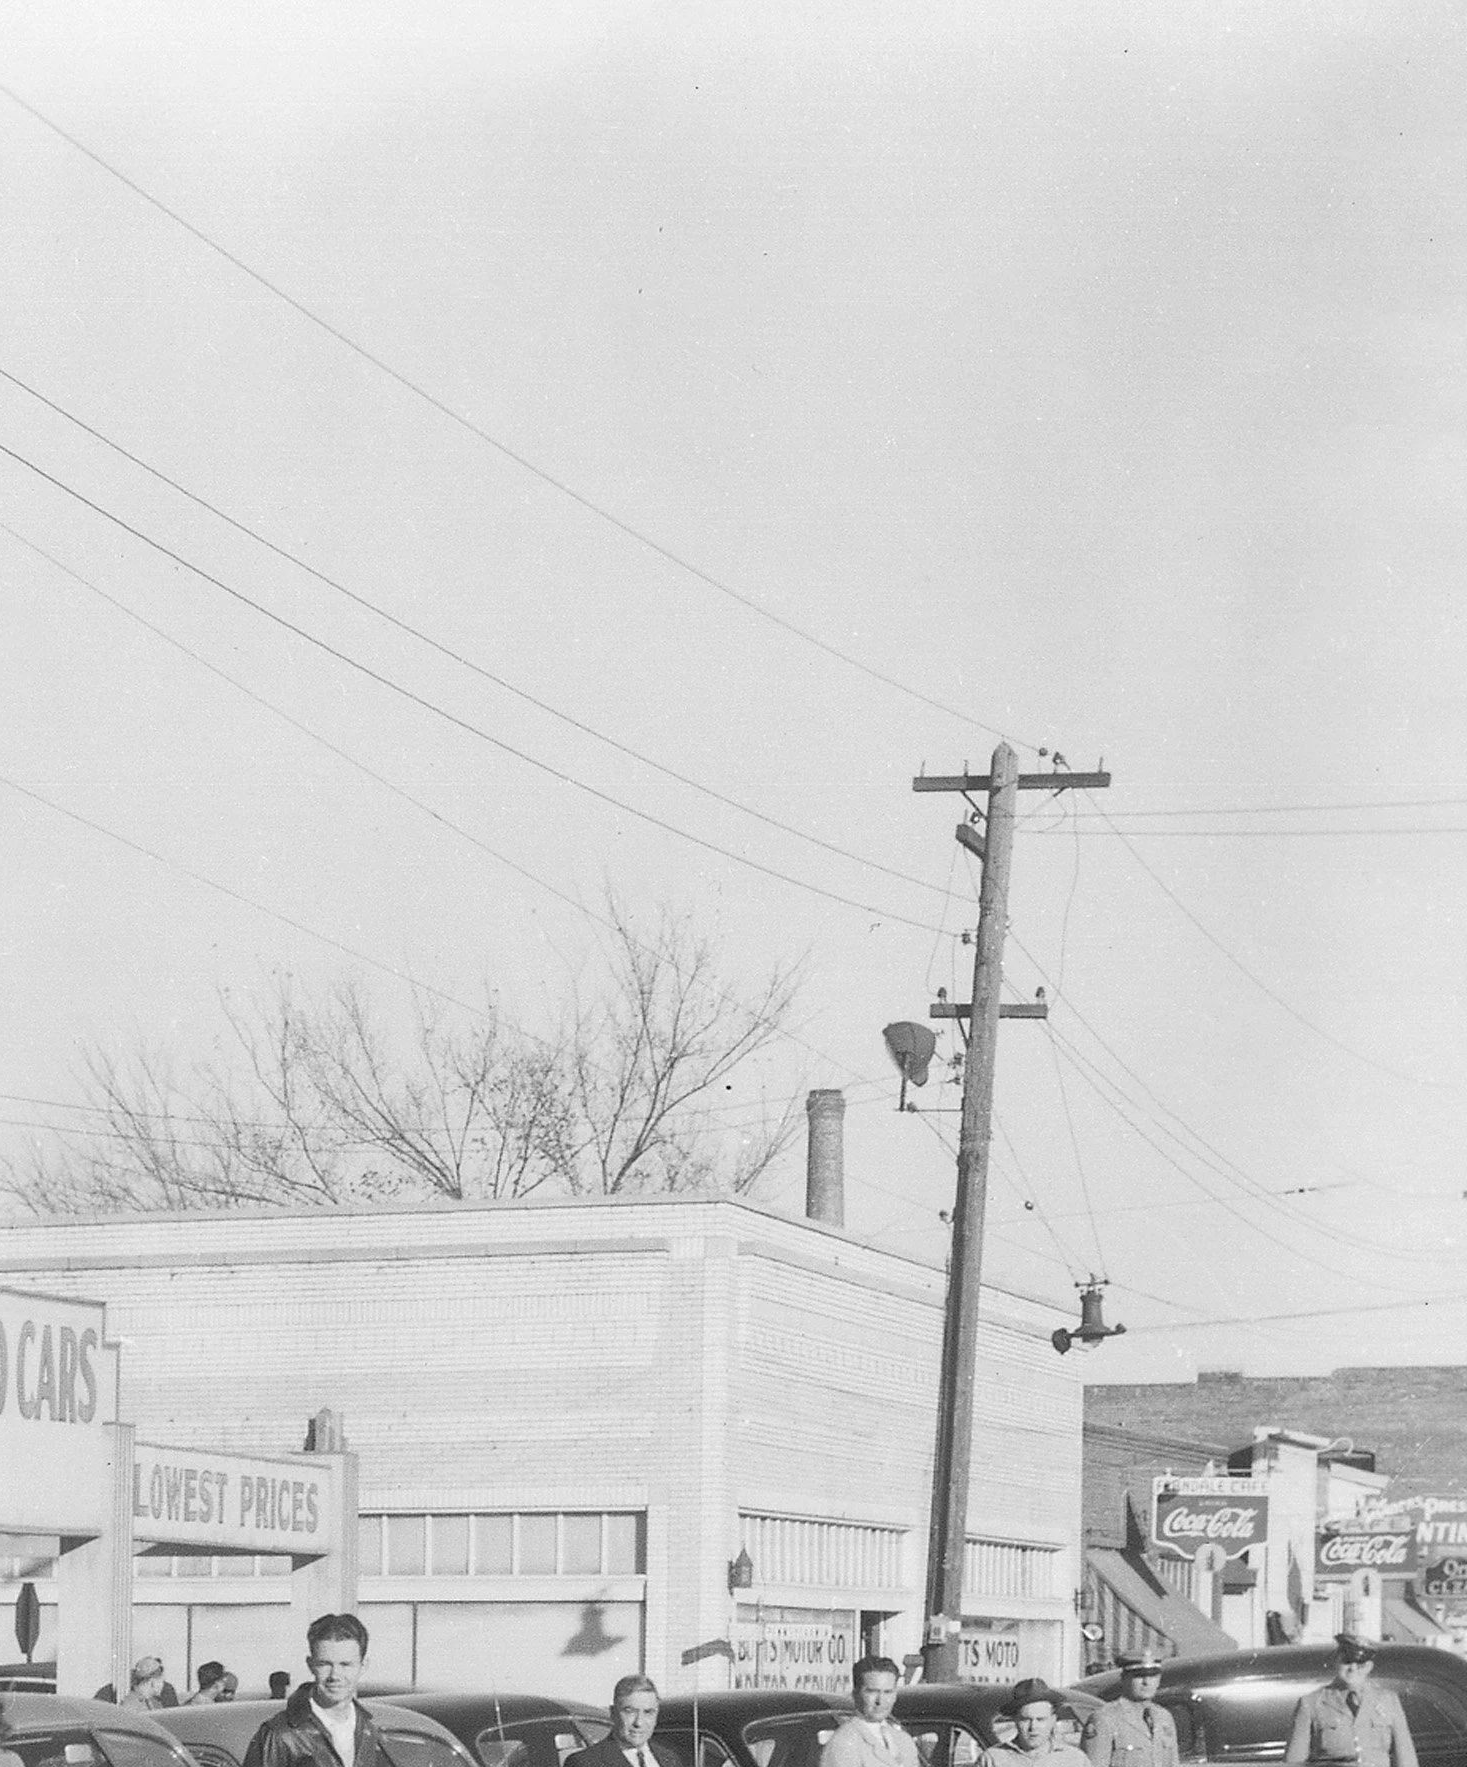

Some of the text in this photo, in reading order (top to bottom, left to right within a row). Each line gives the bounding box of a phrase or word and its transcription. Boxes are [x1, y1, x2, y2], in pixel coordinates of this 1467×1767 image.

[16, 1319, 99, 1424] CARS
[133, 1462, 319, 1534] LOWEST PRICES
